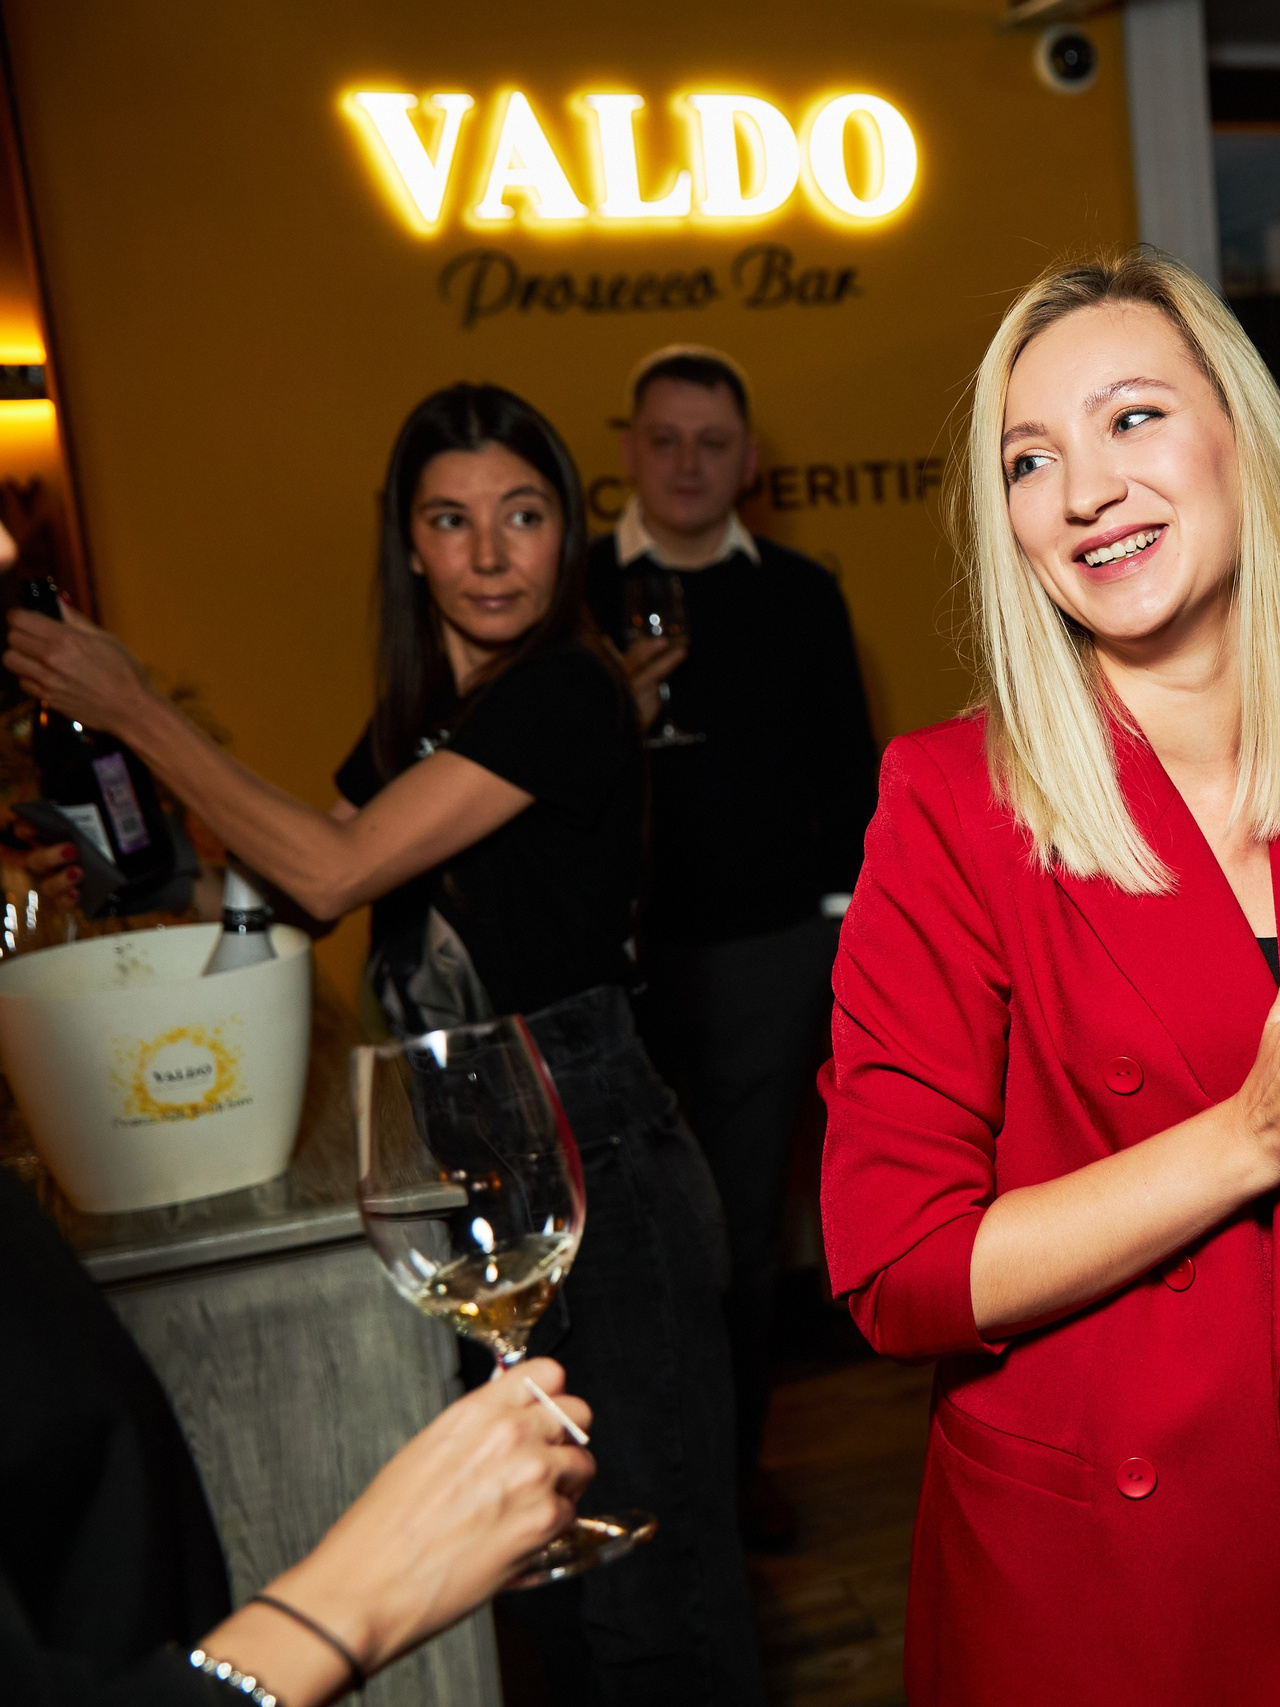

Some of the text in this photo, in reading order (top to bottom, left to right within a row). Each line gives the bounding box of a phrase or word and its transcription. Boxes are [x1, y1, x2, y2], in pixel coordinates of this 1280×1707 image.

[344, 89, 919, 236] VALDO
[439, 241, 864, 330] Prosecco Bar
